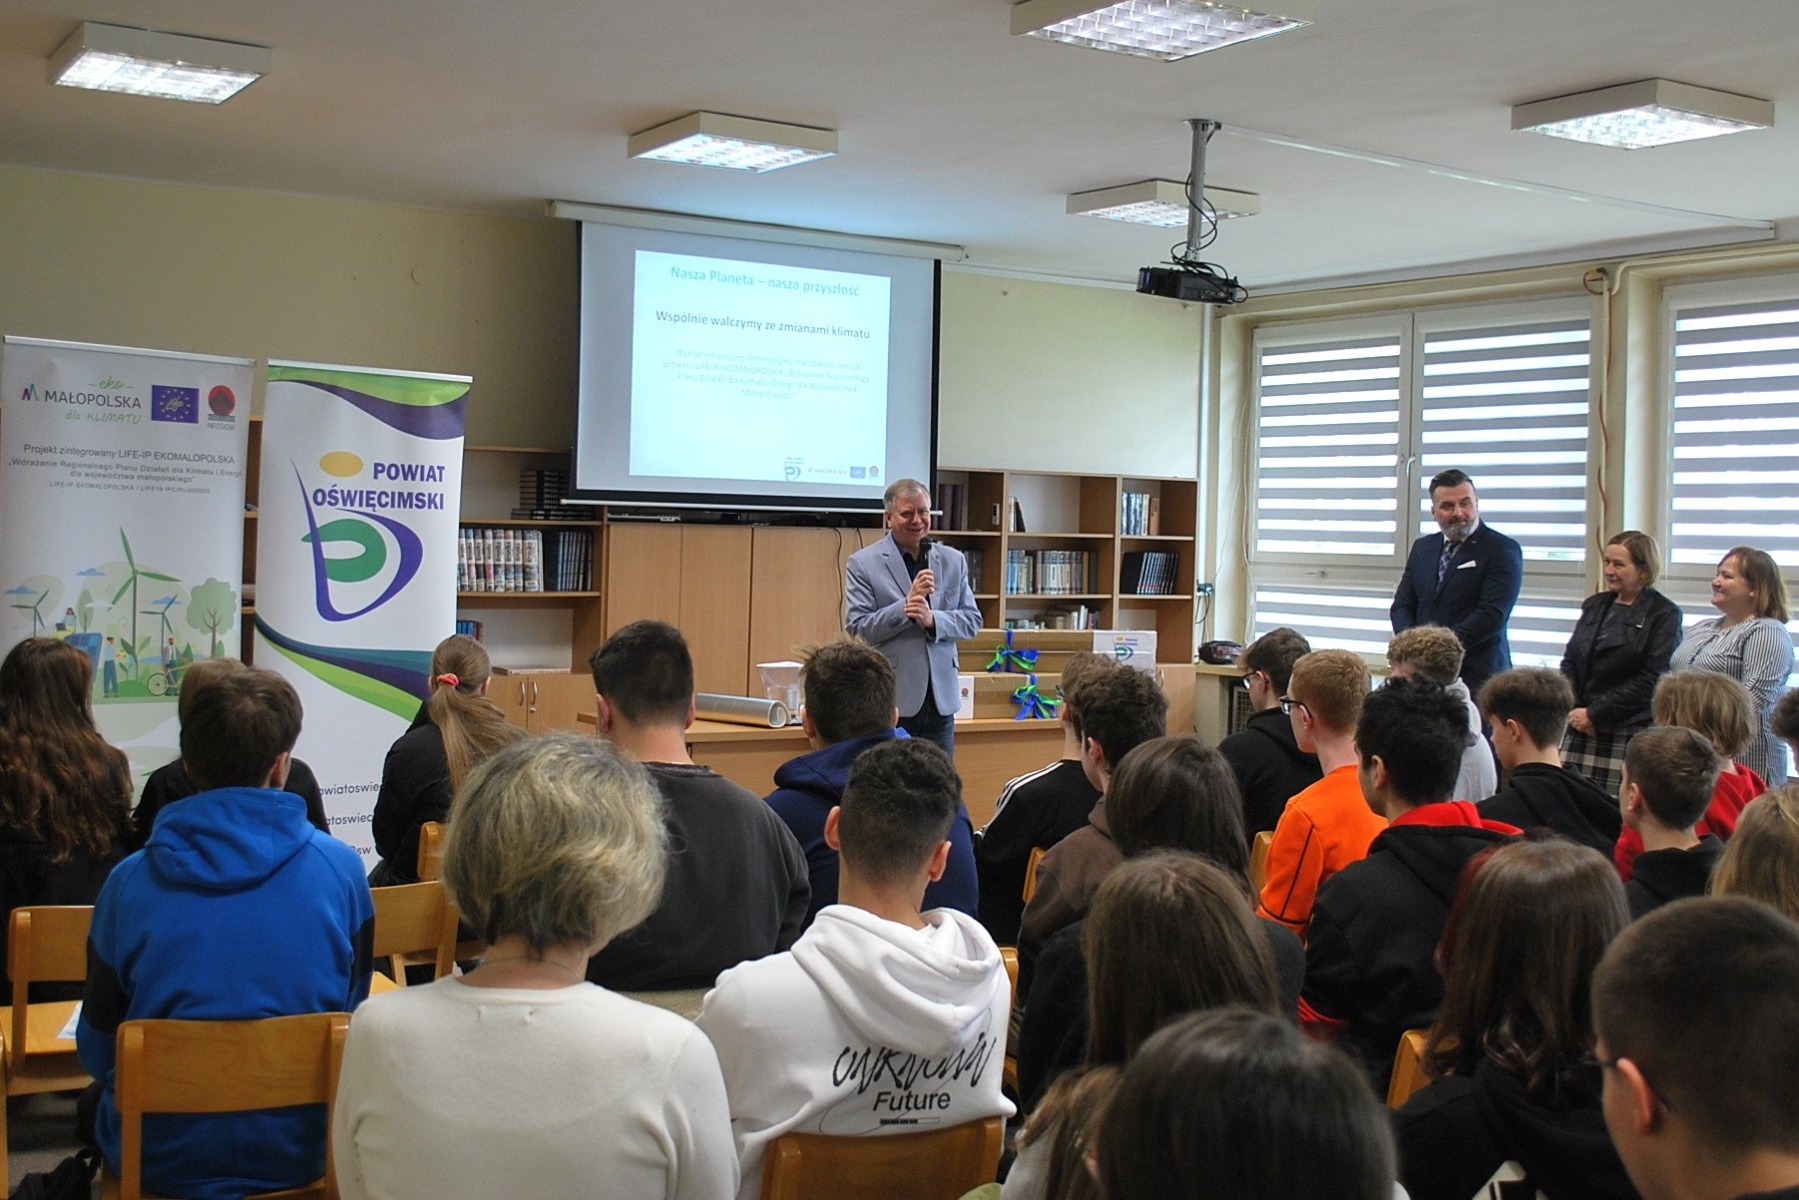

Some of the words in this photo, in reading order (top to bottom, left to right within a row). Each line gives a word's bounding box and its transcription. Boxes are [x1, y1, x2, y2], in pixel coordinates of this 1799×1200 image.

[671, 266, 706, 281] Nasza
[710, 270, 754, 286] Planeta
[768, 278, 799, 290] nasza
[803, 281, 860, 297] przyszłość
[656, 310, 708, 325] Wspólnie
[710, 316, 762, 331] walczymy
[765, 321, 776, 331] ze
[779, 321, 829, 336] zmianami
[831, 325, 870, 339] klimatu
[98, 376, 125, 389] eko
[44, 390, 142, 410] MAŁOPOLSKA
[65, 409, 81, 420] dla
[87, 411, 142, 425] KLIMATU
[24, 444, 57, 456] Projekt
[60, 447, 116, 459] zintegrowany
[118, 449, 152, 460] LIFE-IP
[60, 460, 113, 471] Regionalnego
[115, 463, 138, 472] Planu
[140, 464, 170, 473] Działań
[172, 466, 184, 474] dla
[186, 467, 214, 476] Klimatu
[84, 471, 135, 480] województwa
[373, 462, 445, 483] POWIAT
[312, 484, 445, 512] OŚWIĘCIMSKI
[873, 1091, 950, 1111] Future
